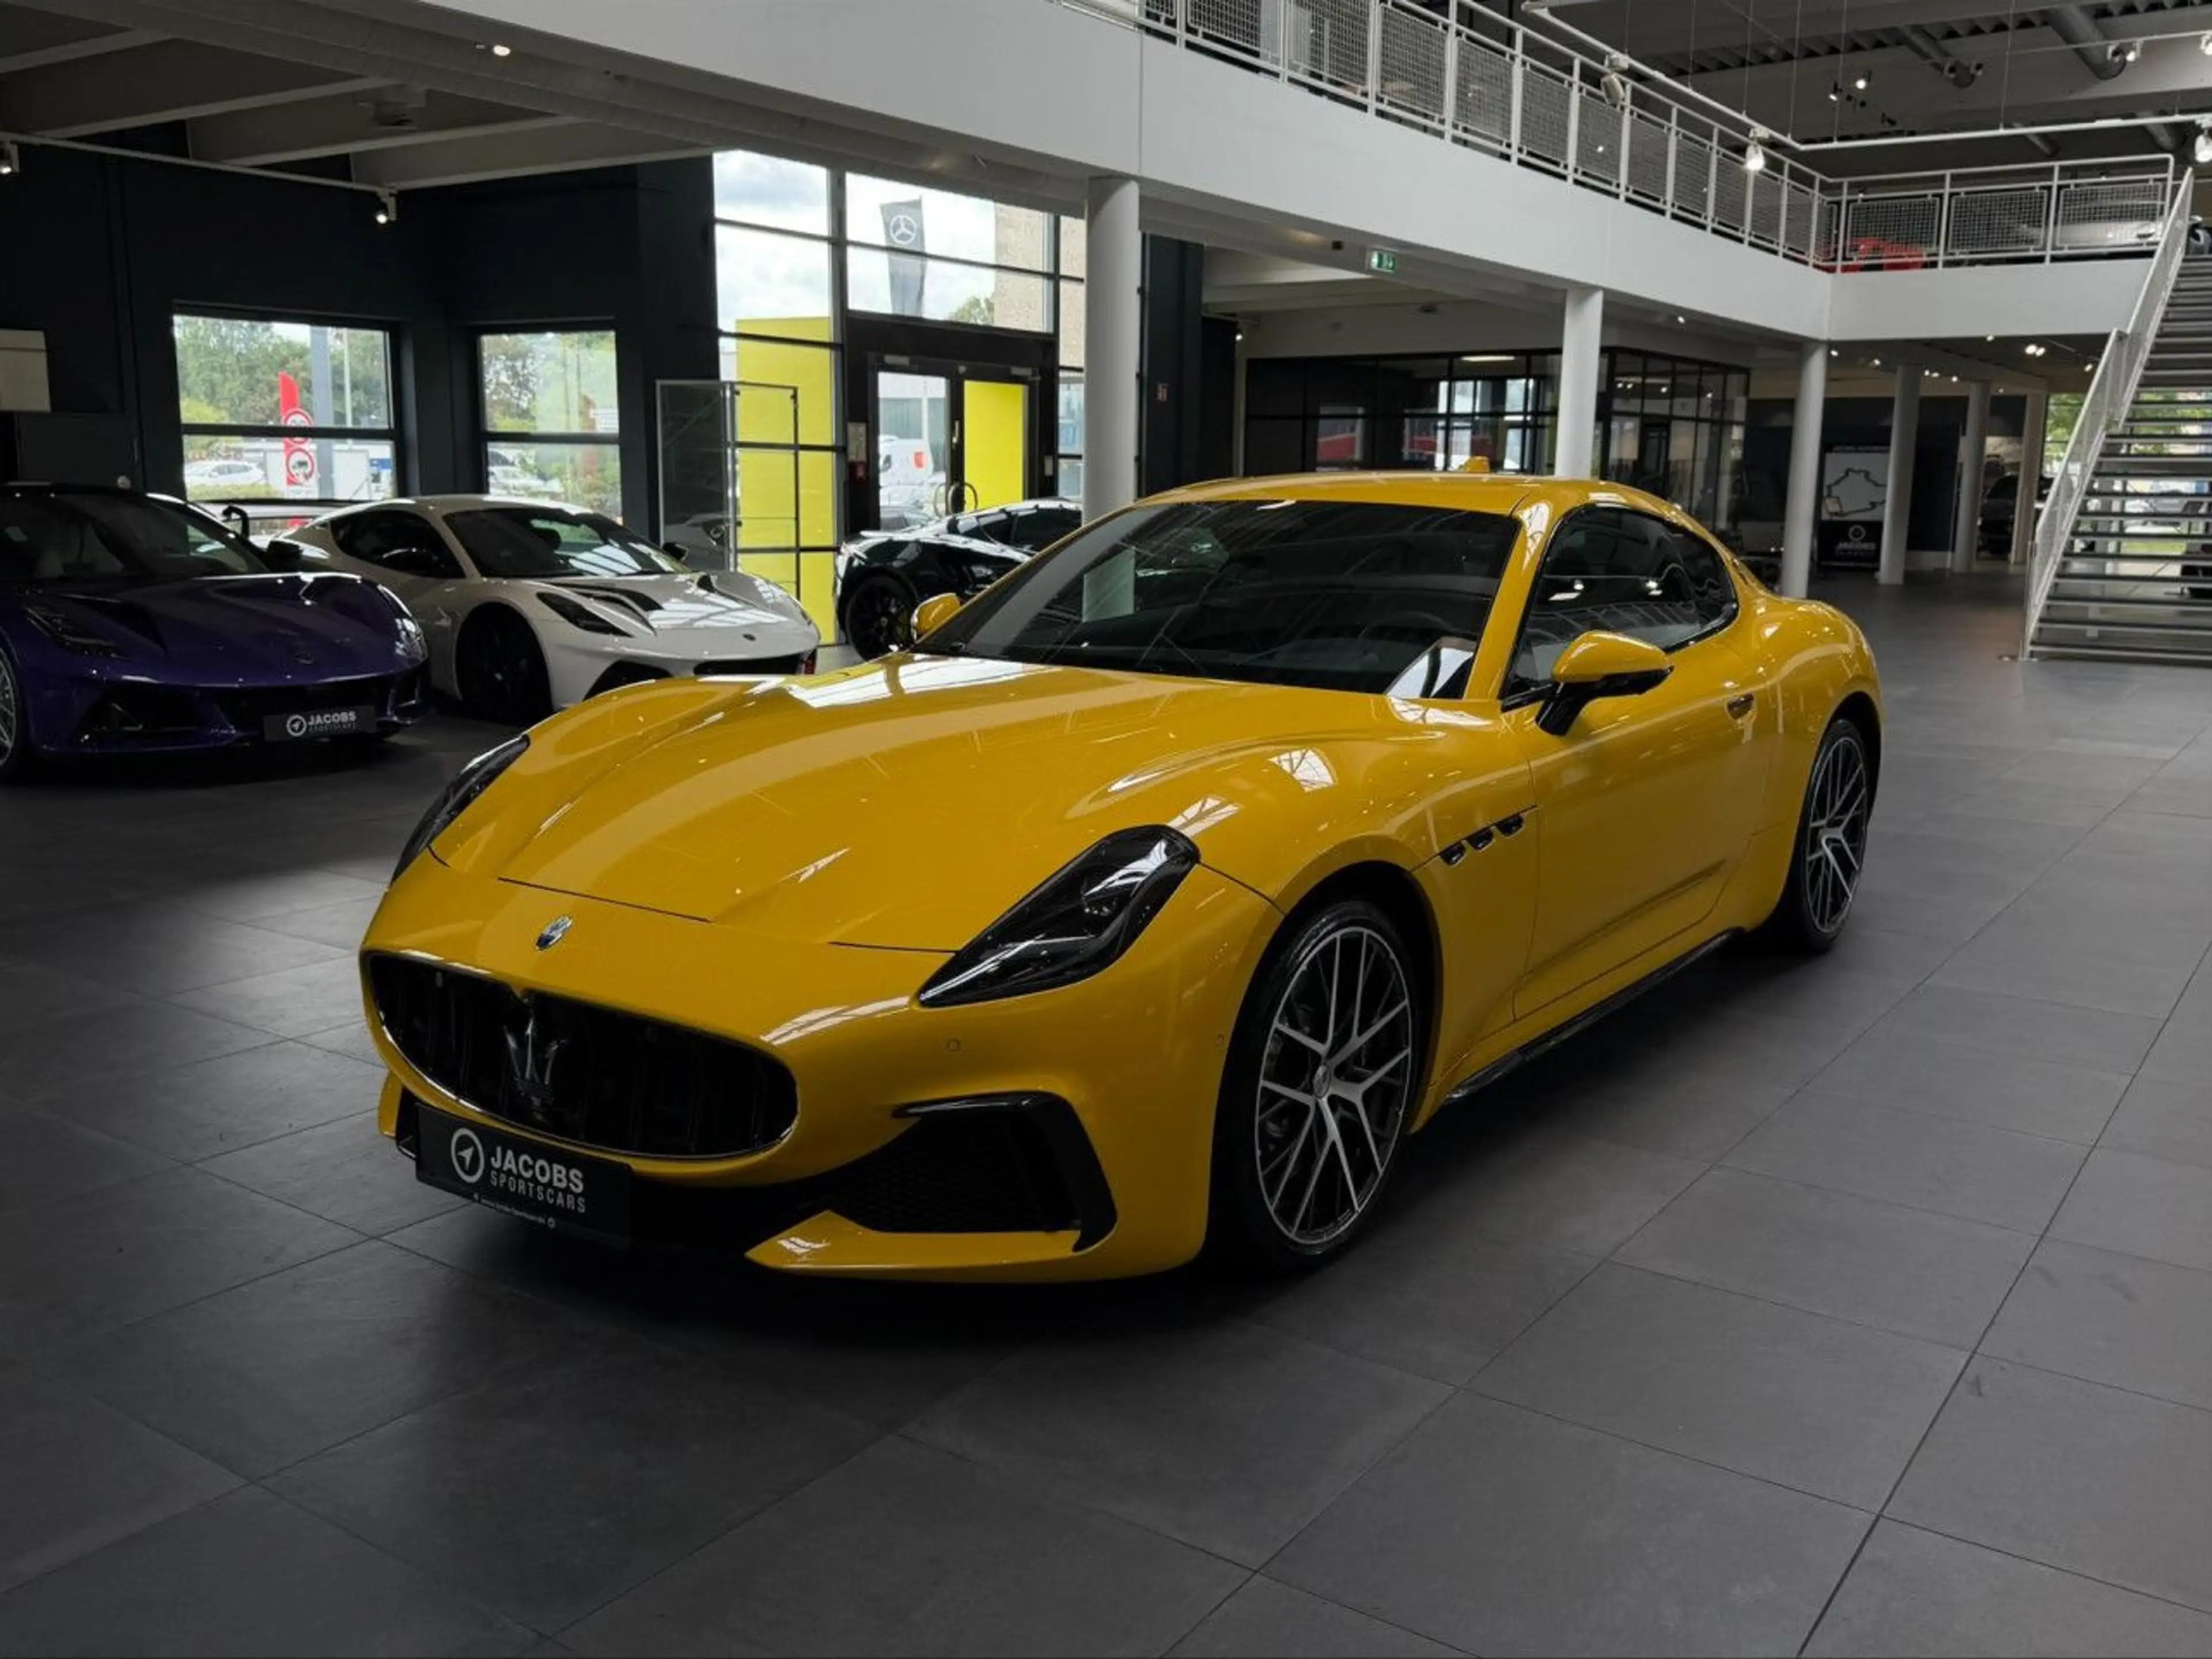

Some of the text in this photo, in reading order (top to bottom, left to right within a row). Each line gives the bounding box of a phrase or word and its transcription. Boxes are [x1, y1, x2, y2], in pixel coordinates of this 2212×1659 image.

[308, 710, 356, 725] JACOBS
[491, 1146, 584, 1193] JACOBS
[491, 1170, 585, 1213] SPORTSCARS
